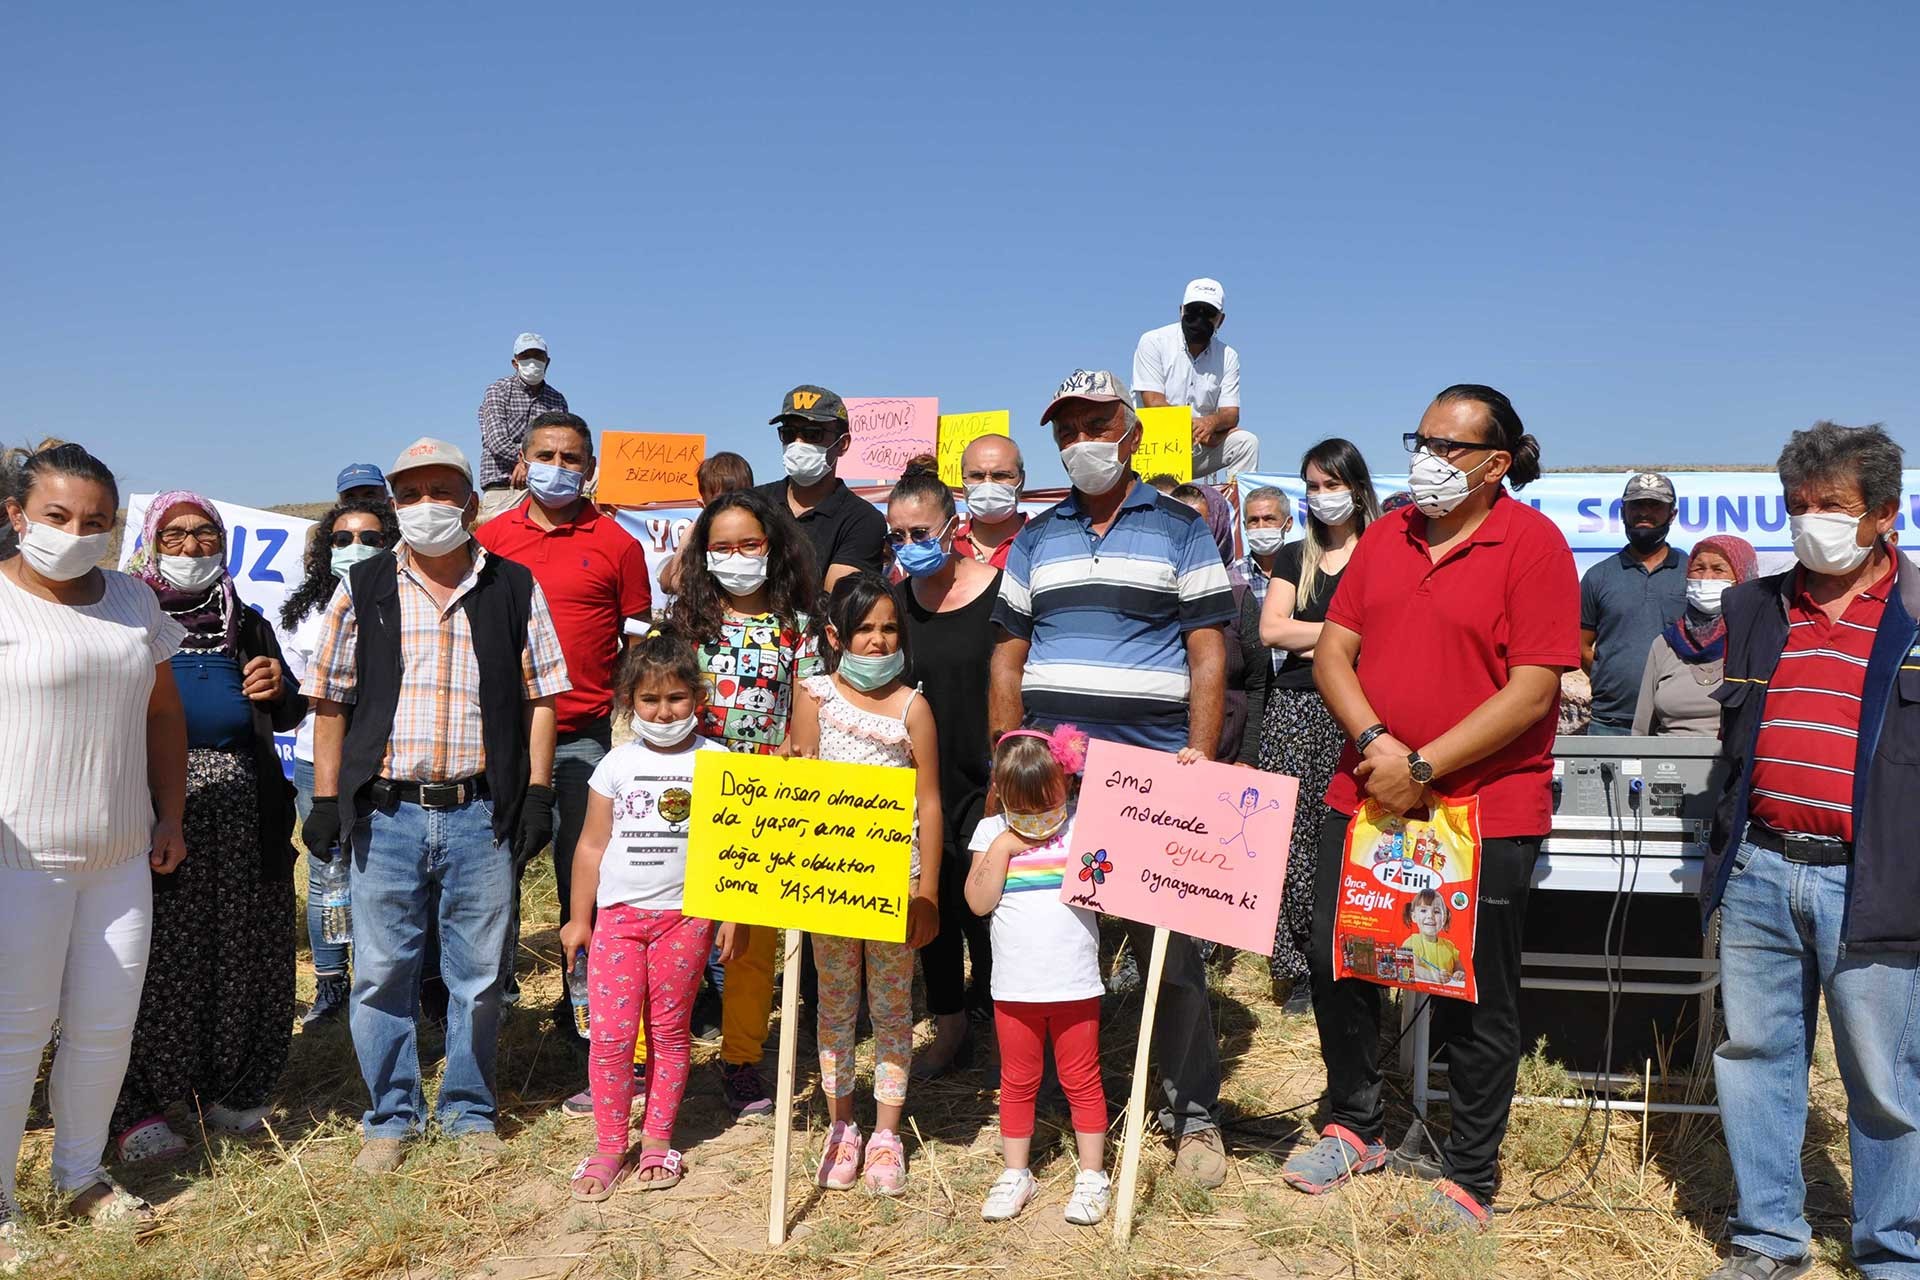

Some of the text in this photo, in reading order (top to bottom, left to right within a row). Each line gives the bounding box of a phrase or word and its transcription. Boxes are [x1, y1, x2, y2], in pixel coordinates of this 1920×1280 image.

[793, 392, 821, 410] W
[616, 438, 701, 465] KAYALAR
[1137, 443, 1158, 456] ELT
[721, 771, 905, 811] Doğa insan olmadan
[1105, 770, 1153, 794] ama
[712, 807, 742, 827] da
[814, 822, 855, 838] ama
[866, 822, 912, 844] insan
[1120, 805, 1209, 835] madende
[718, 844, 875, 874] doğa yok olduktan
[1343, 875, 1368, 890] Önce
[780, 879, 902, 917] YAŞAYAMAZ!
[1239, 891, 1258, 911] ki
[1344, 888, 1396, 912] Sağlık
